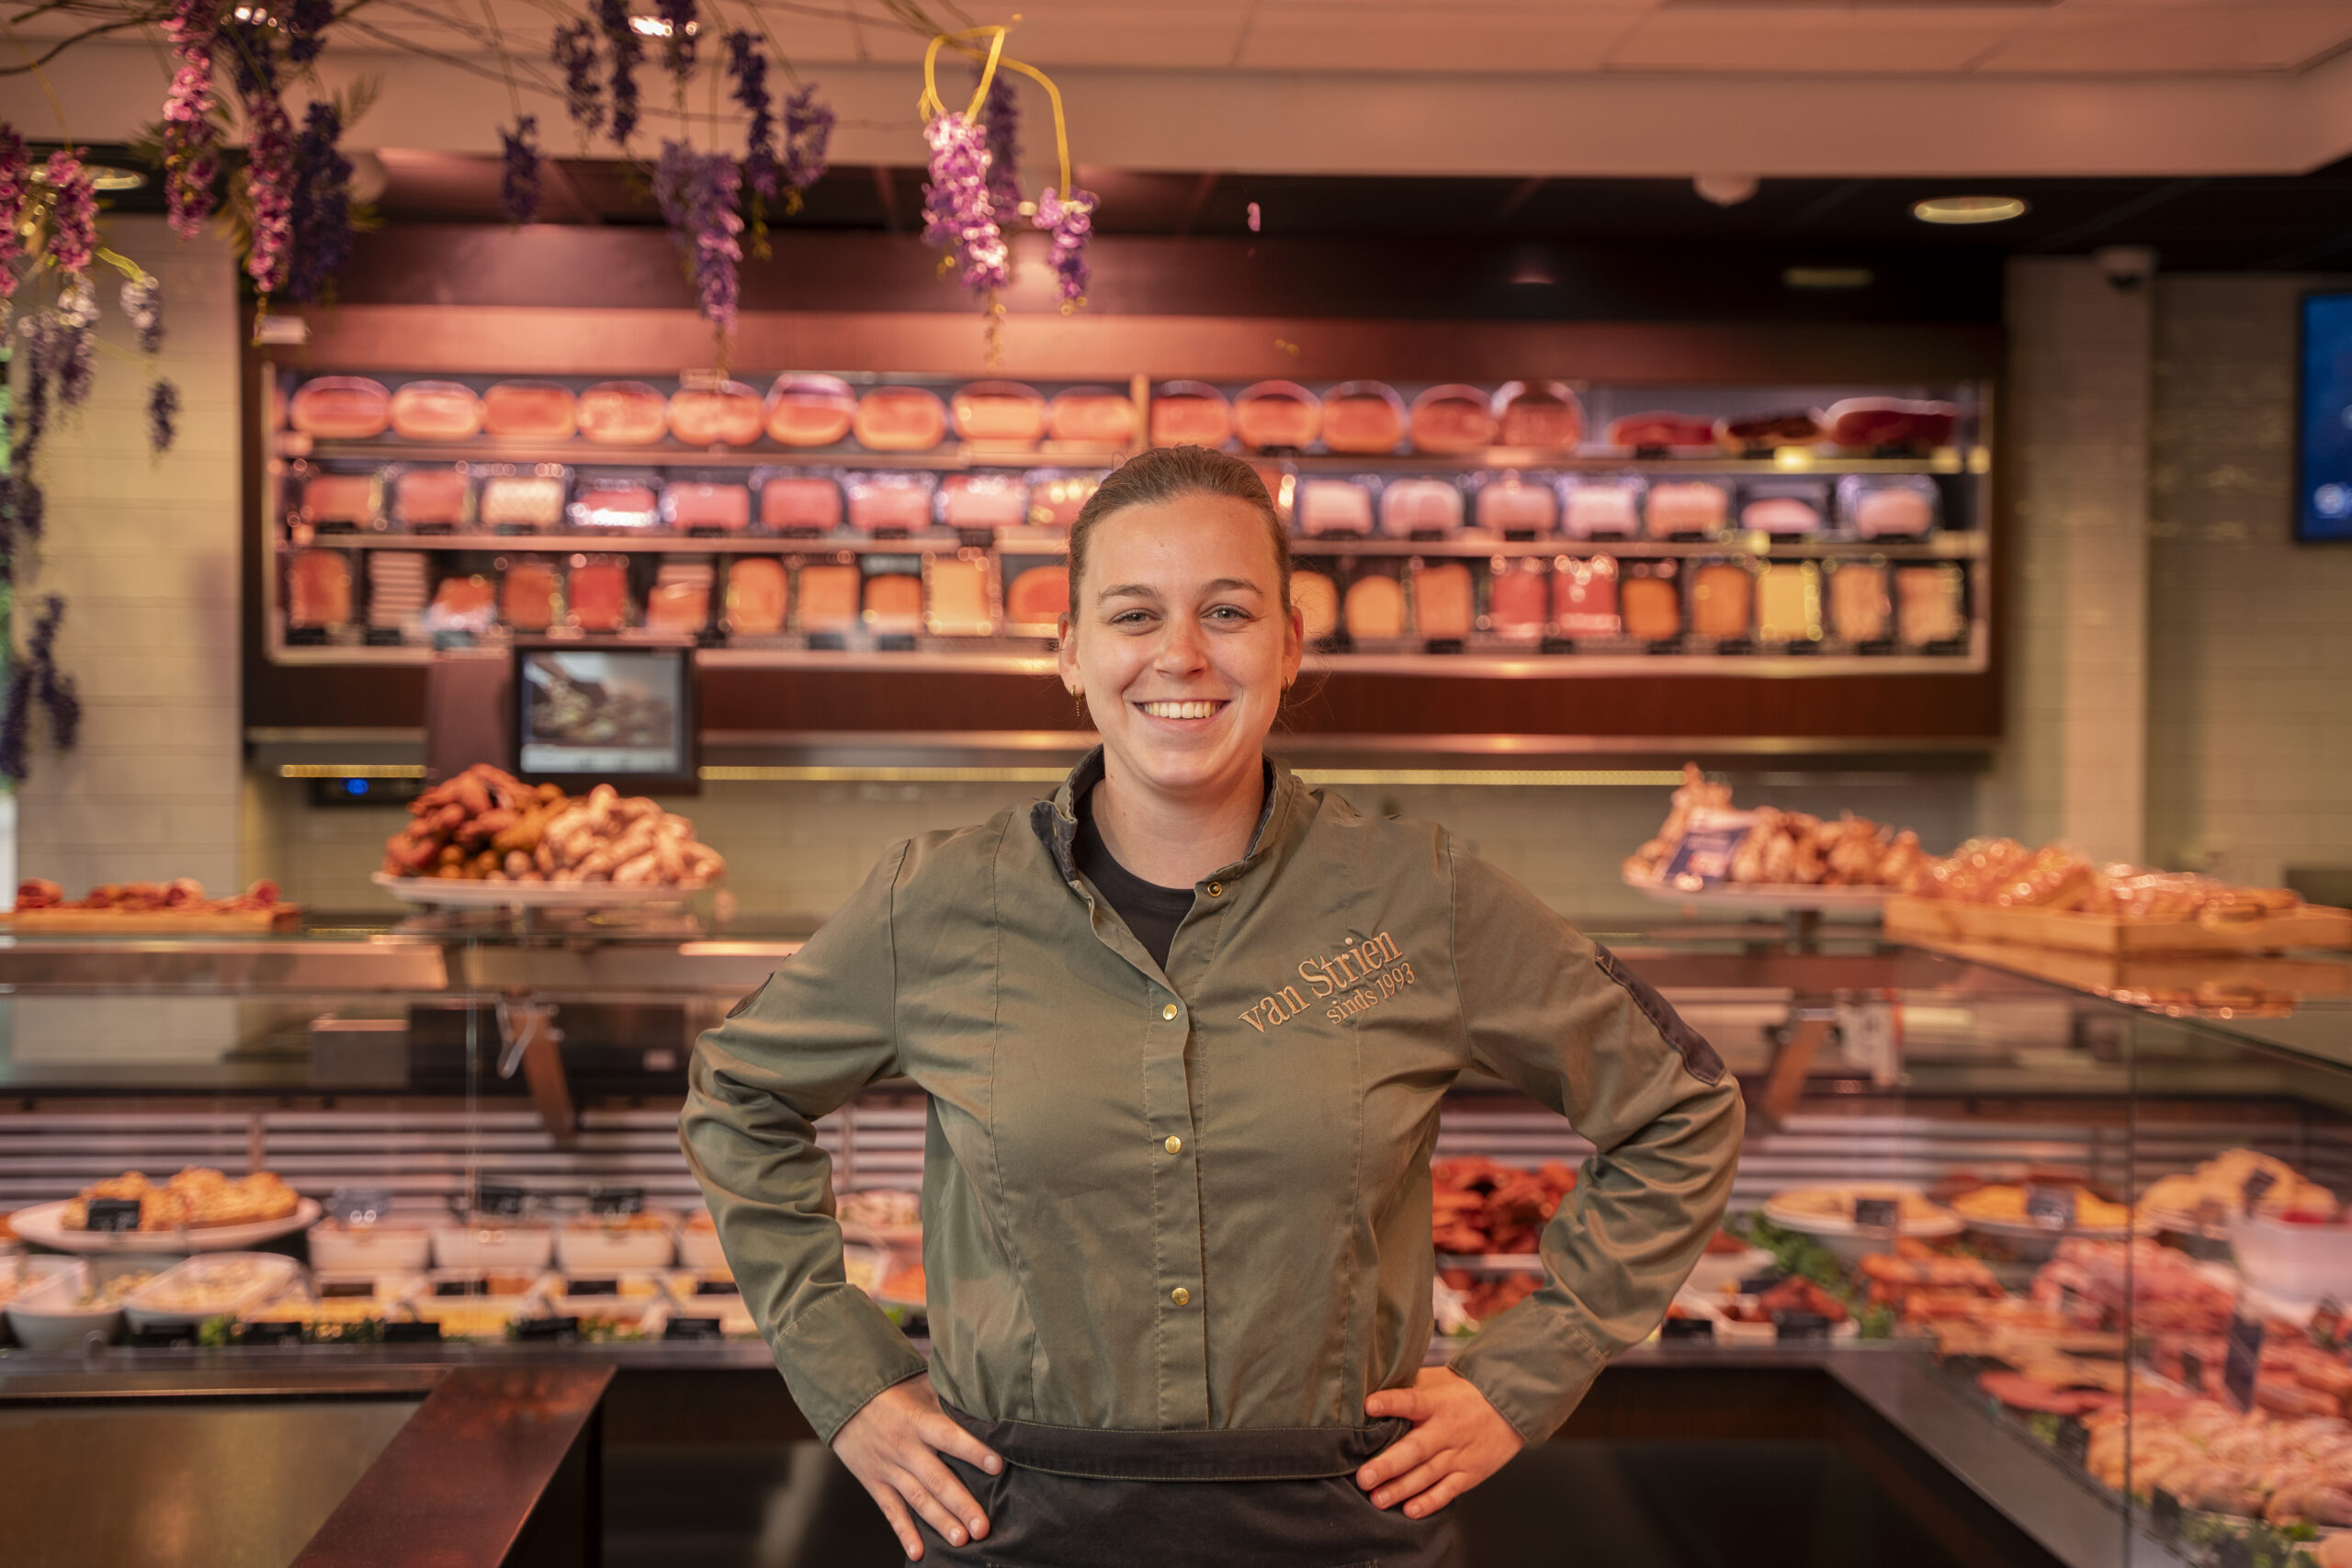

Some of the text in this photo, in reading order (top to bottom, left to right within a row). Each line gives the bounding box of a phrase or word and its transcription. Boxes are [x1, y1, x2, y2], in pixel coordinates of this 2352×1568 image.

[1238, 931, 1403, 1033] van Strien
[1326, 963, 1416, 1024] sinds 1993
